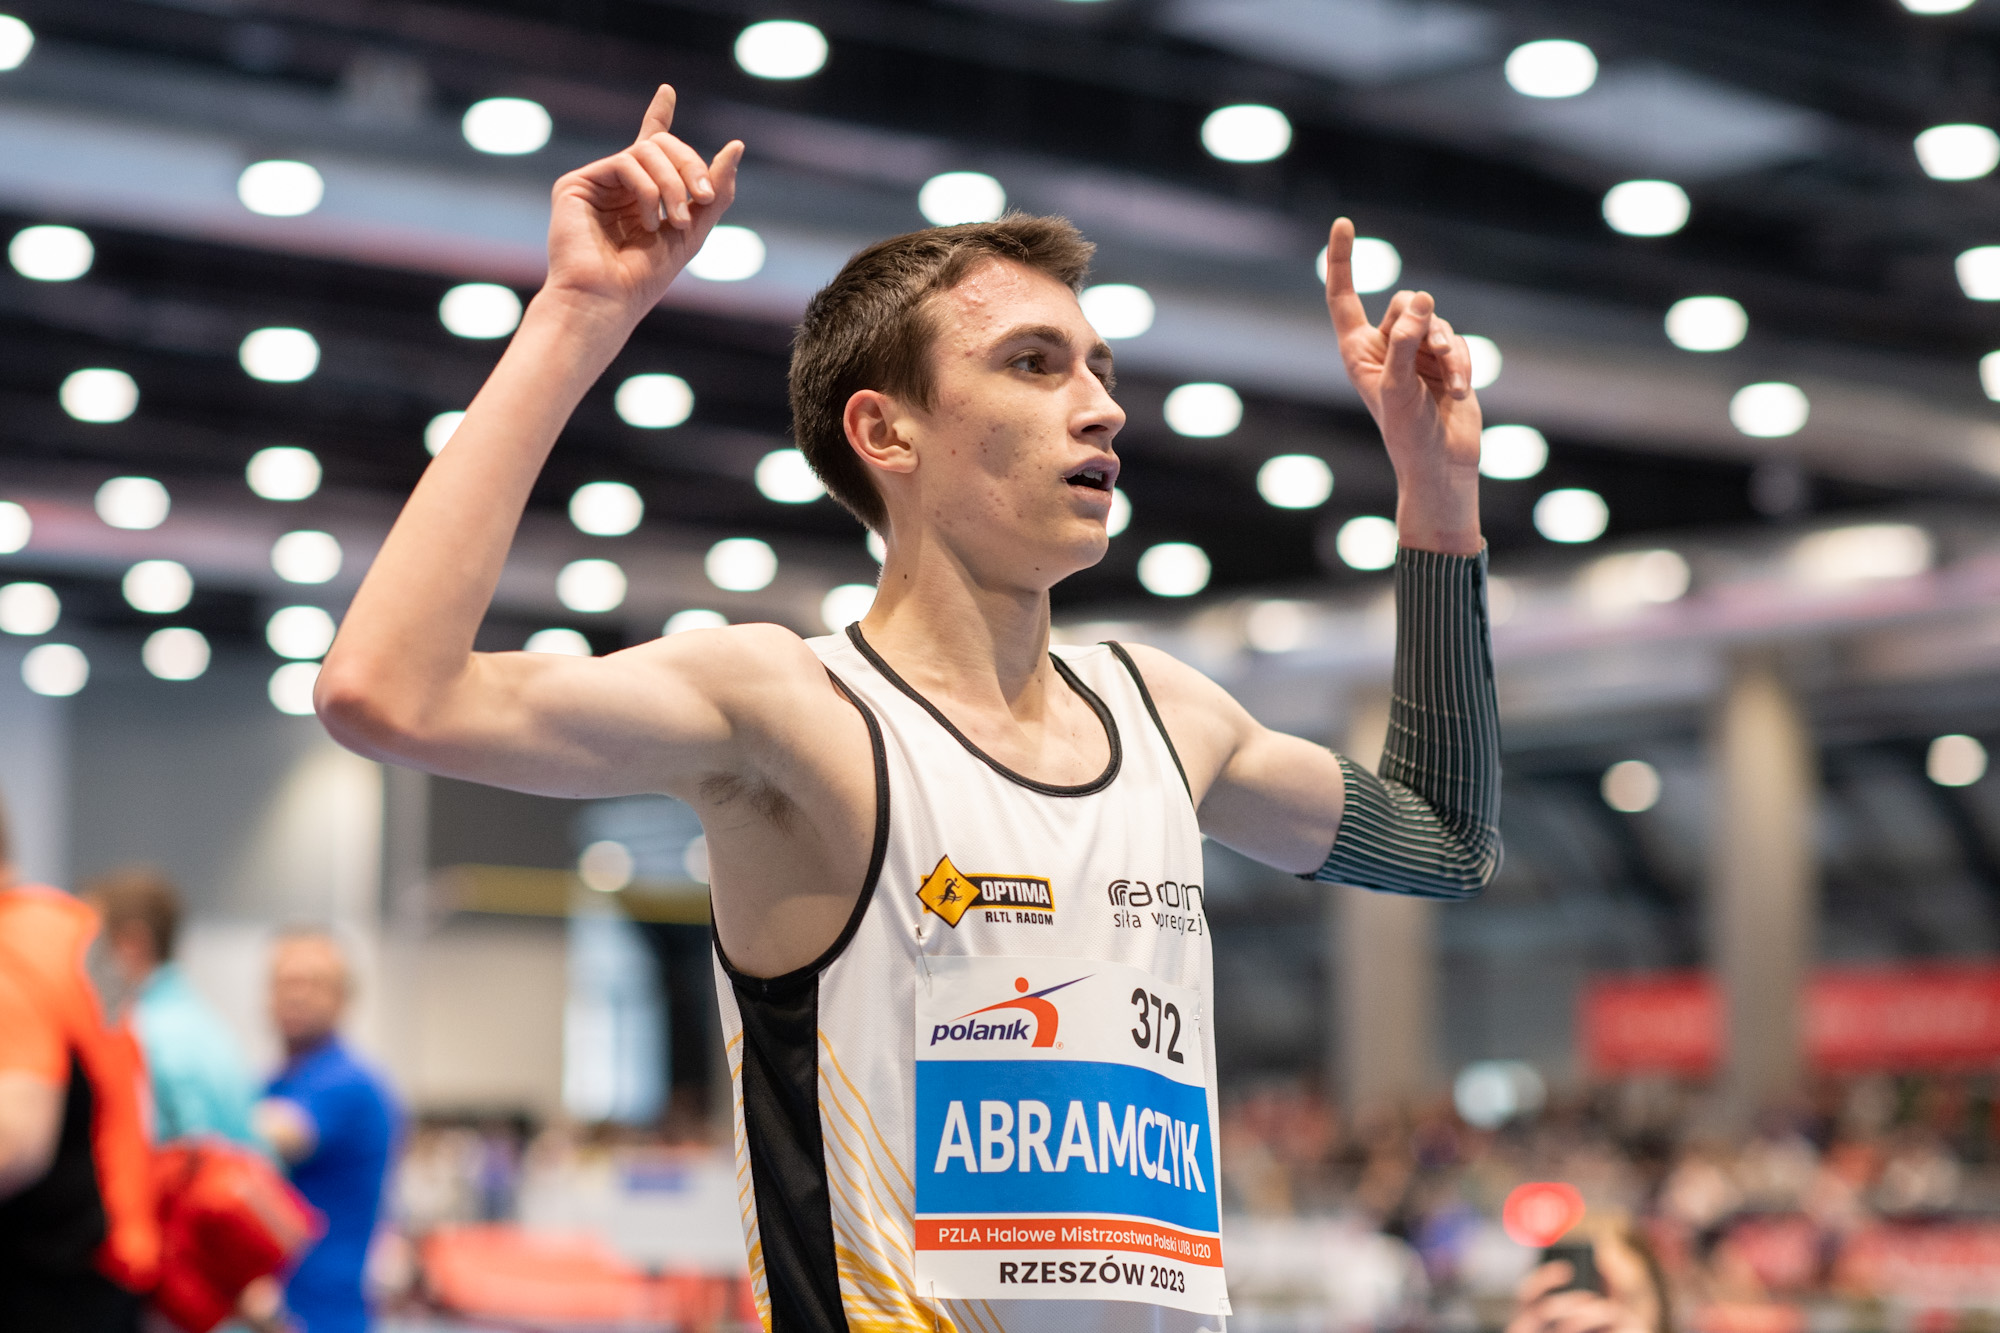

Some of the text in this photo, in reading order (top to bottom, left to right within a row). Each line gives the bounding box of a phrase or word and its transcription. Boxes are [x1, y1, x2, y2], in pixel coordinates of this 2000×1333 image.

[981, 880, 1051, 905] OPTIMA
[985, 911, 1054, 925] RLTL RADOM
[930, 1018, 1031, 1047] polanik
[1130, 987, 1185, 1065] 372
[933, 1100, 1207, 1193] ABRAMCZYK
[938, 1226, 1211, 1259] PZLA Halowe Mistrzostwa Polski U18 U20
[1000, 1254, 1185, 1294] RZESZÓW 2023
